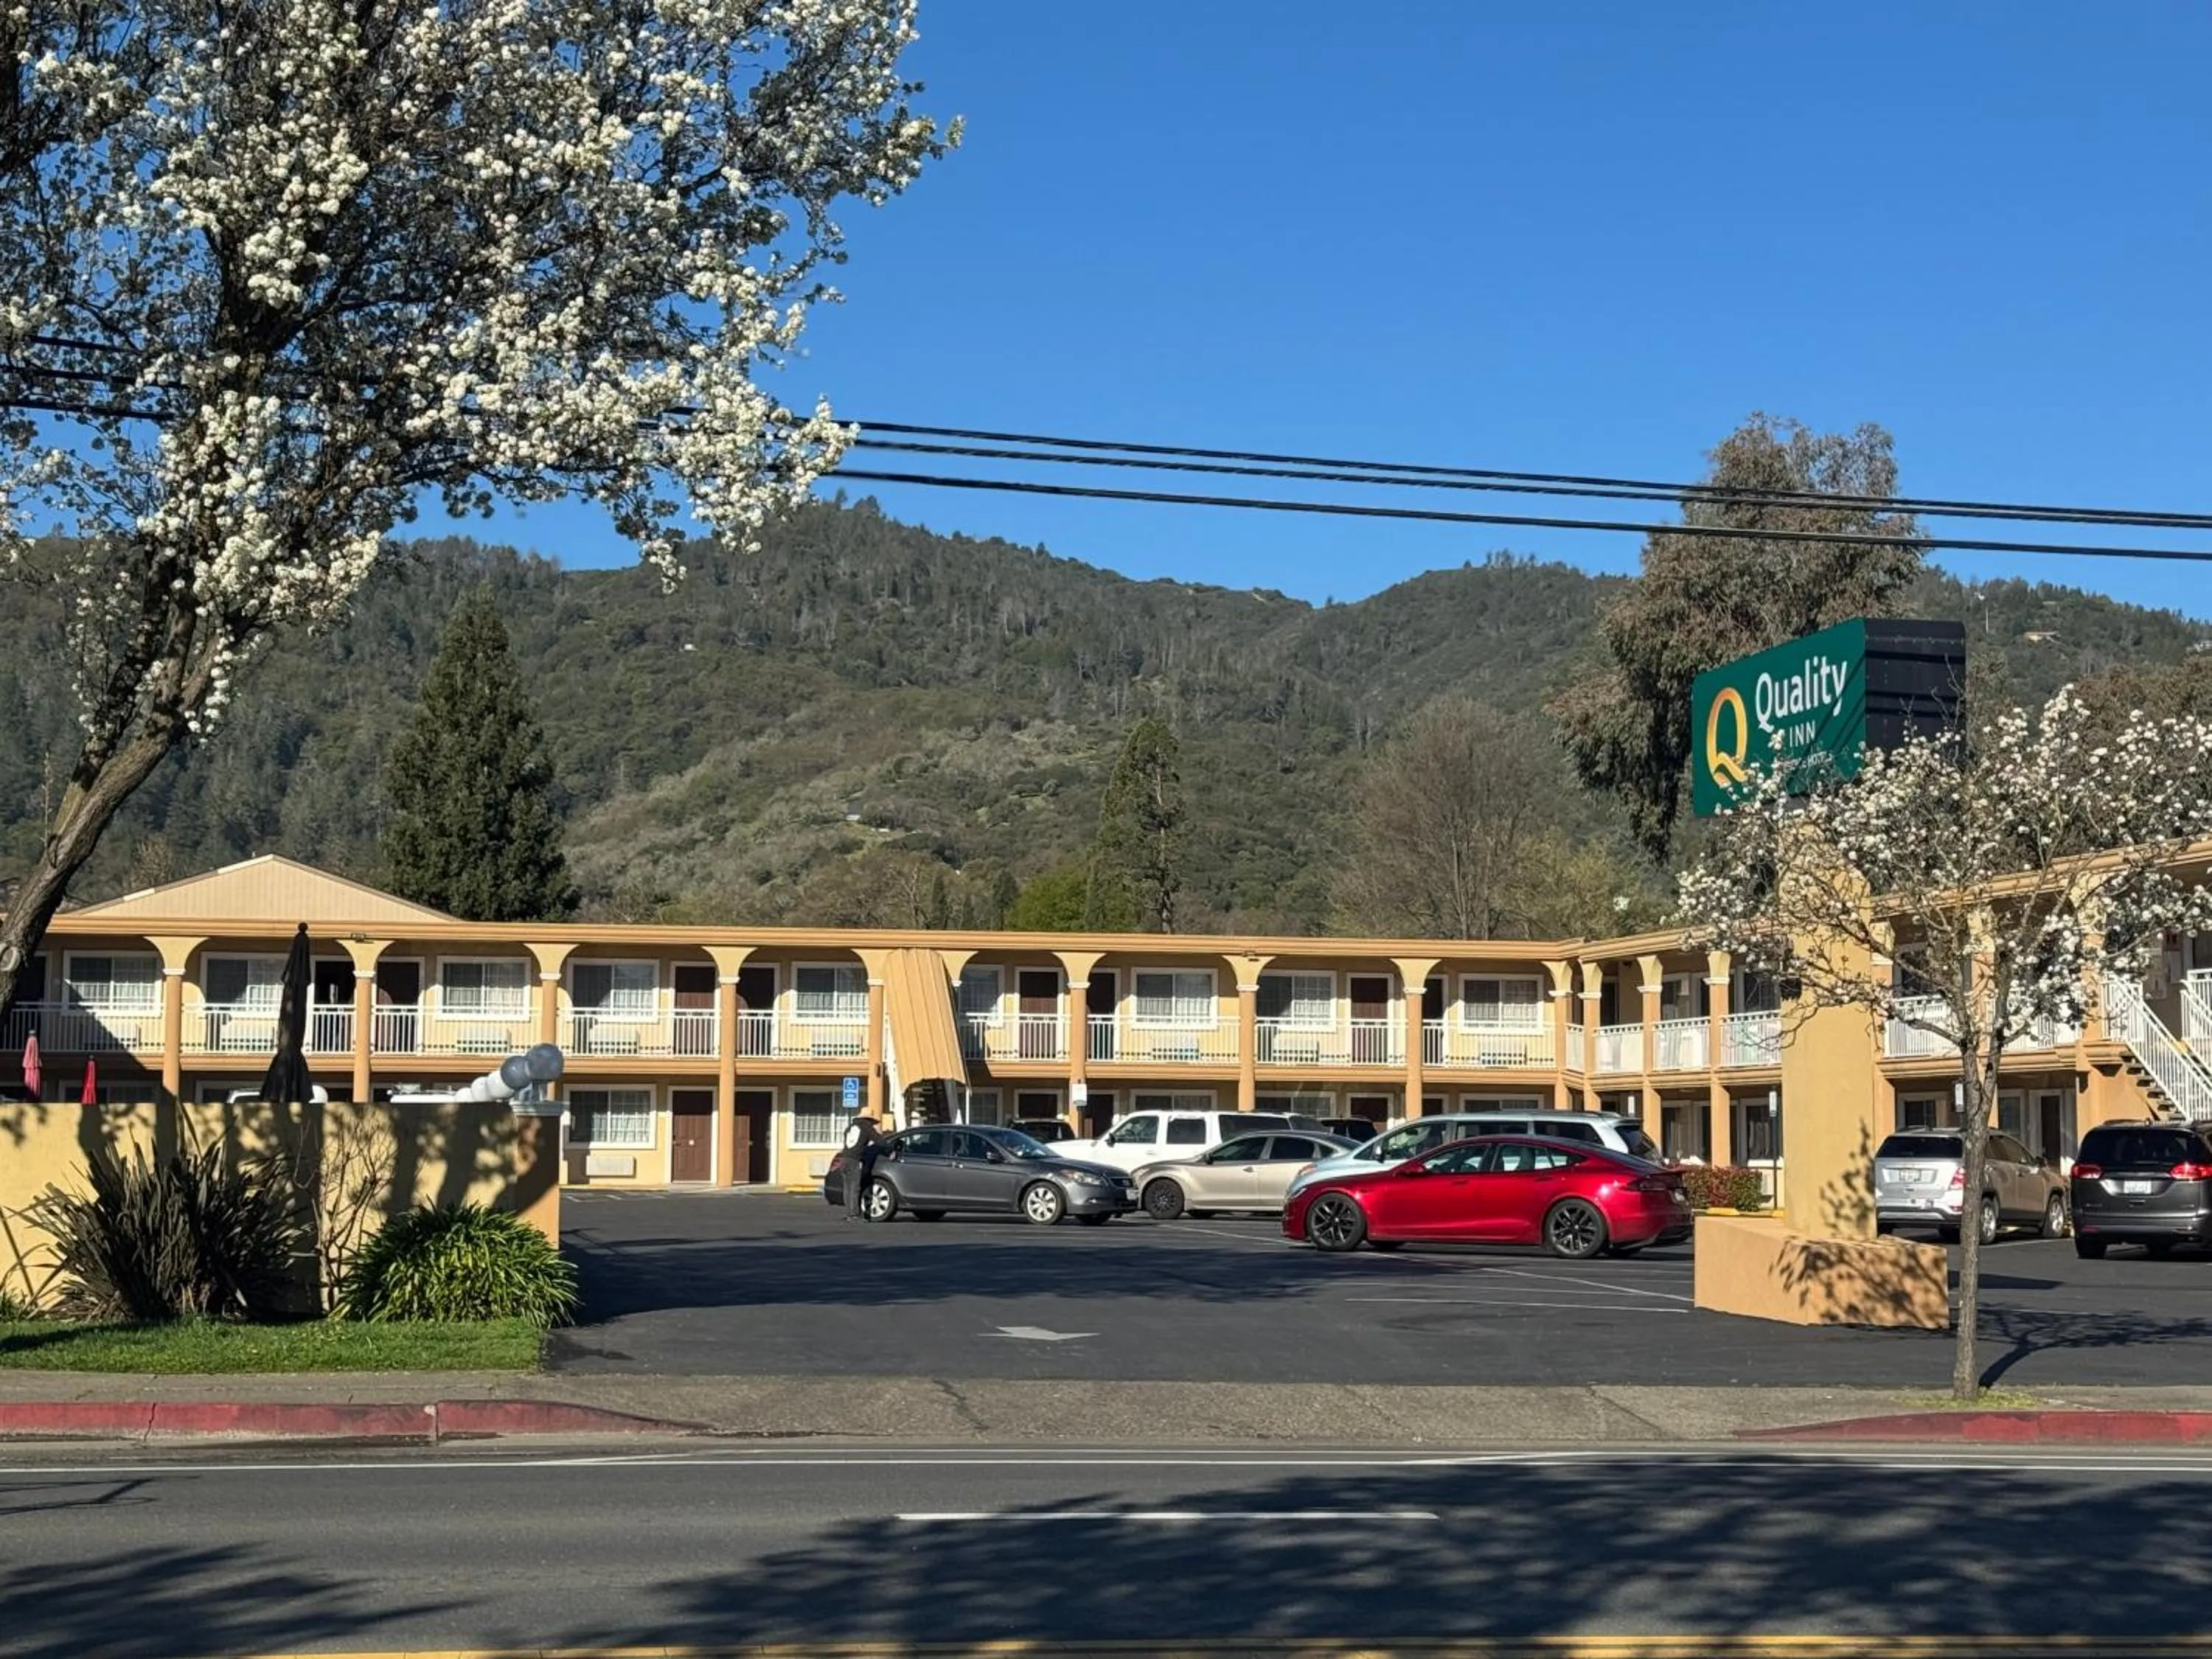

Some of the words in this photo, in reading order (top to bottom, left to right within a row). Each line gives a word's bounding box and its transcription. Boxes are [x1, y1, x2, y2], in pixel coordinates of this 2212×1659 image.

[1756, 655, 1847, 734] Quality
[1789, 719, 1816, 748] INN
[1706, 686, 1747, 789] Q
